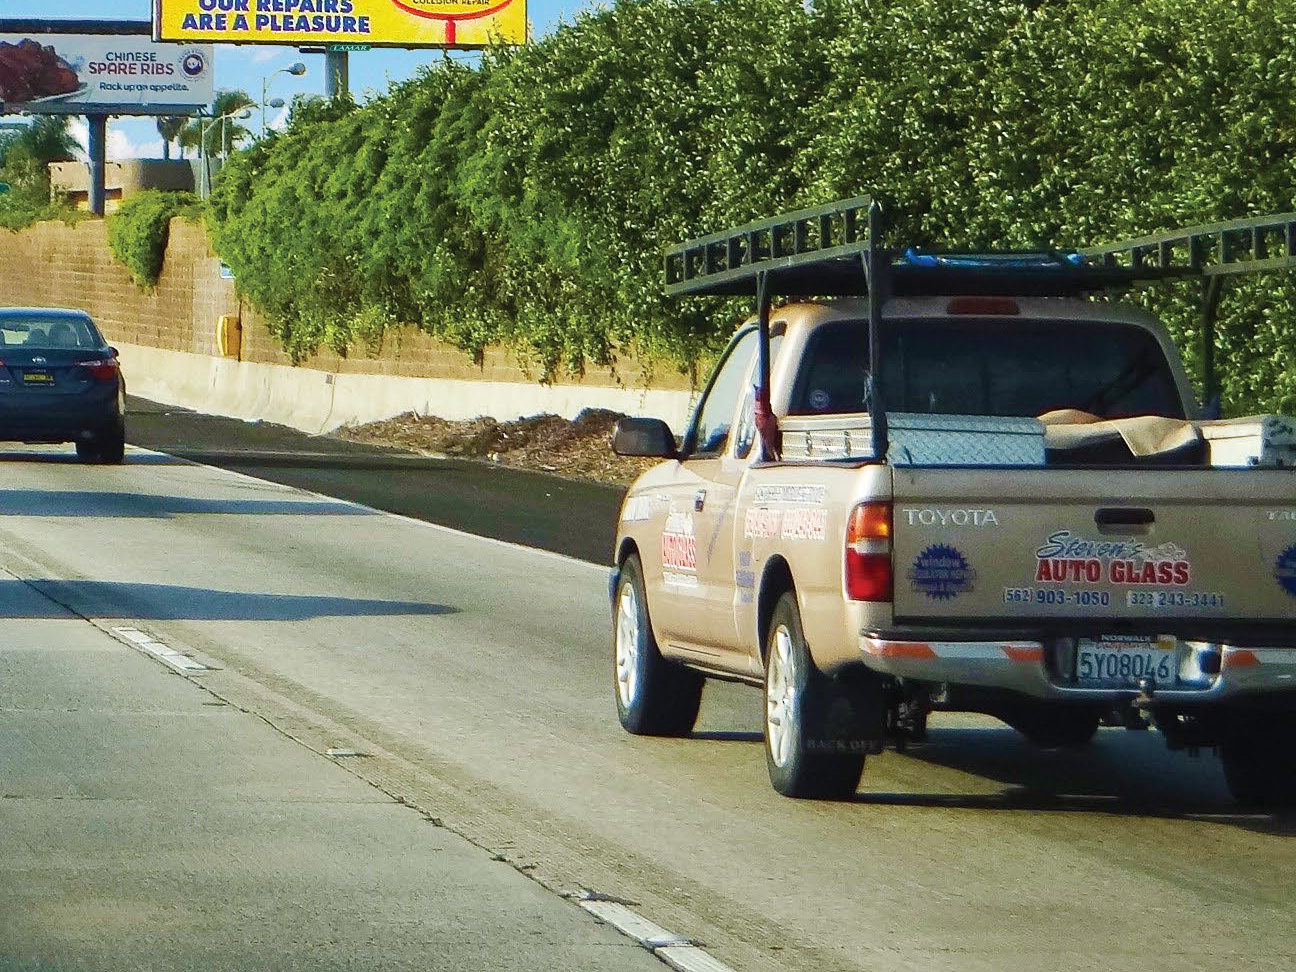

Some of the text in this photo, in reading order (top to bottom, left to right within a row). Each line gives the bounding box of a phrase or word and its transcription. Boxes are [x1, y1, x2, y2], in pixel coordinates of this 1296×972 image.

[181, 13, 371, 33] ARE A PLEASURE
[105, 52, 157, 62] CHINESE
[88, 61, 174, 76] SPARE RIBS
[99, 81, 123, 91] Rack
[124, 83, 135, 93] up
[136, 83, 149, 91] an
[902, 509, 999, 526] TOYOTA
[1036, 530, 1143, 559] Steven's
[1036, 558, 1190, 585] AUTO GLASS
[1080, 653, 1169, 678] 5Y08046
